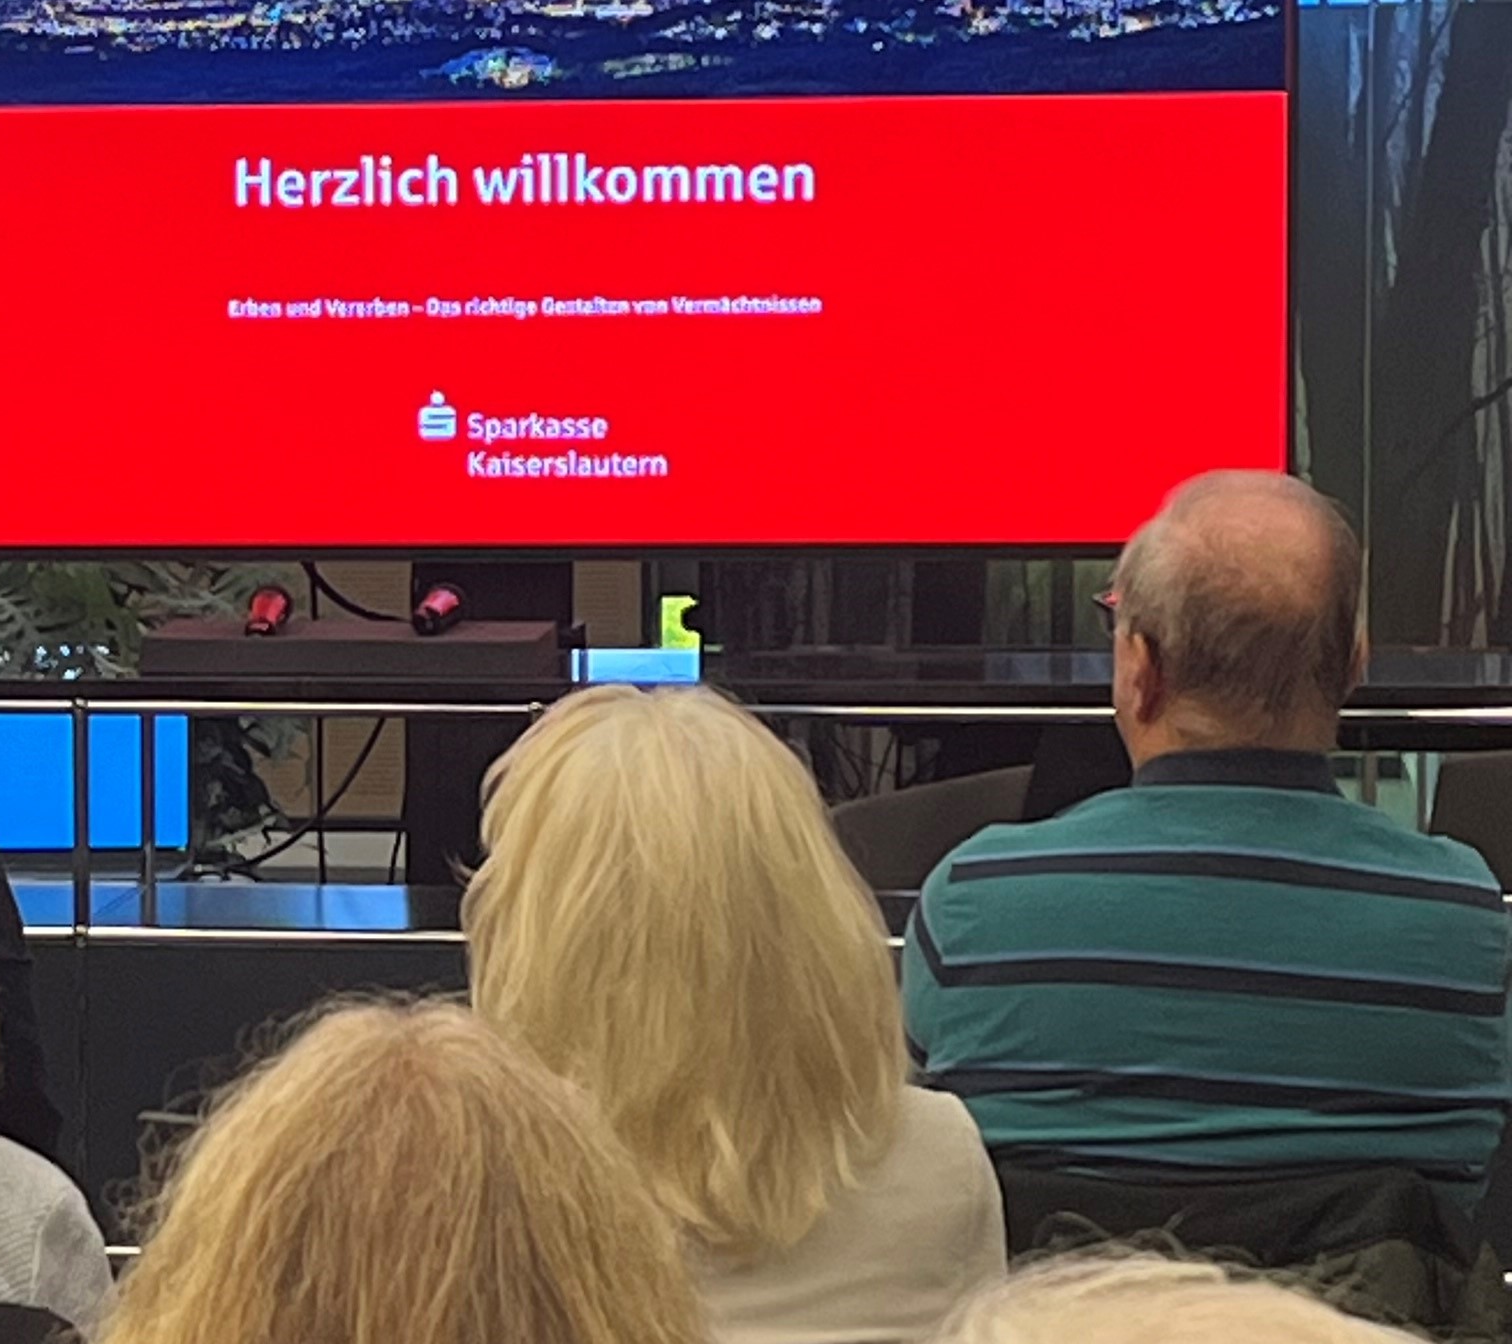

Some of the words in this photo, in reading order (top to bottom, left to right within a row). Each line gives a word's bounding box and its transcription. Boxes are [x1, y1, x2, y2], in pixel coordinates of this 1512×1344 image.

[234, 154, 458, 208] Herzlich
[473, 153, 815, 205] willkommen
[228, 298, 281, 318] Erben
[286, 298, 322, 318] und
[325, 297, 409, 318] Vererben
[426, 297, 461, 318] Das
[464, 295, 537, 320] richtige
[541, 296, 630, 317] Gestalten
[671, 294, 823, 316] Vermächtnissen
[467, 412, 609, 444] Sparkasse
[467, 450, 668, 477] Kaiserslautern
